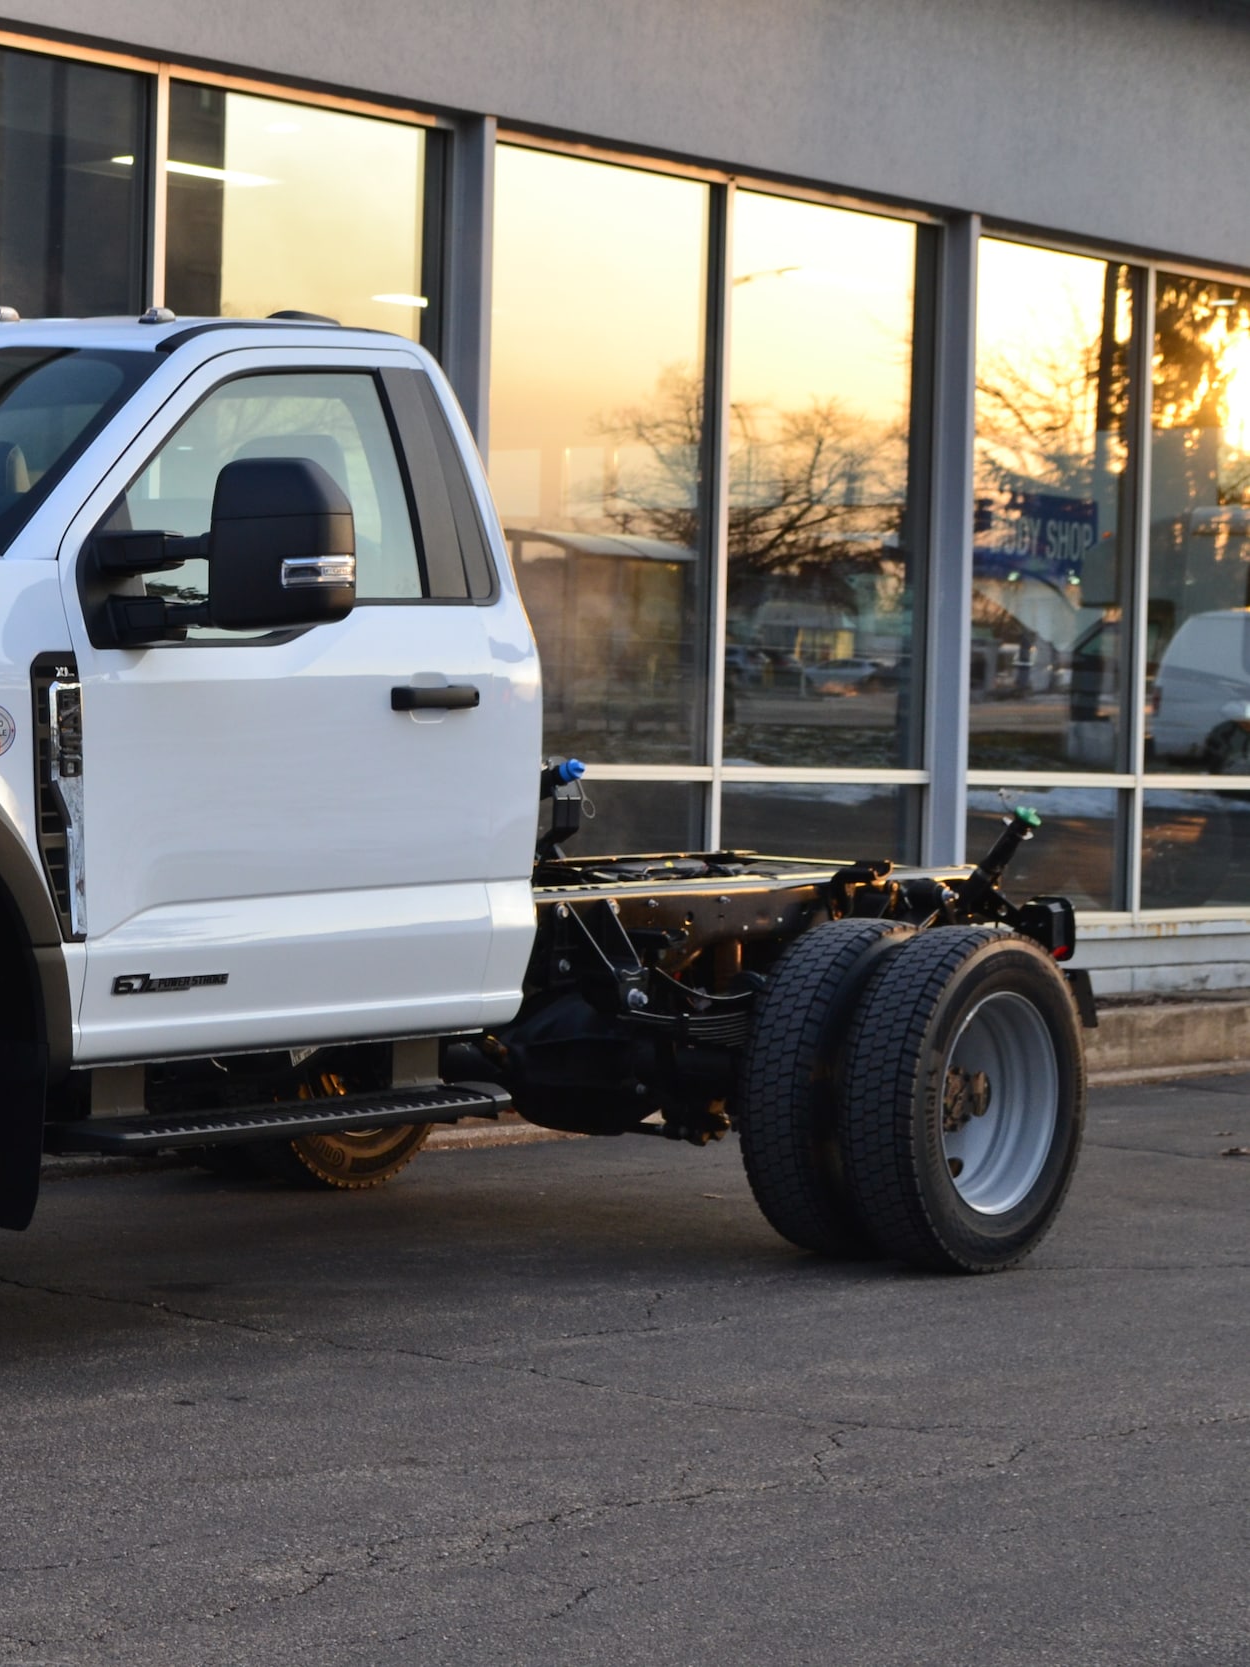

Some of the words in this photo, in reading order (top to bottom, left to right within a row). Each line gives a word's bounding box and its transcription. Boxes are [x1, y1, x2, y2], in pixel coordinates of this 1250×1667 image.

[1045, 518, 1093, 562] SHOP
[54, 666, 75, 678] XL
[158, 977, 190, 987] POWER
[191, 974, 228, 985] STROKE
